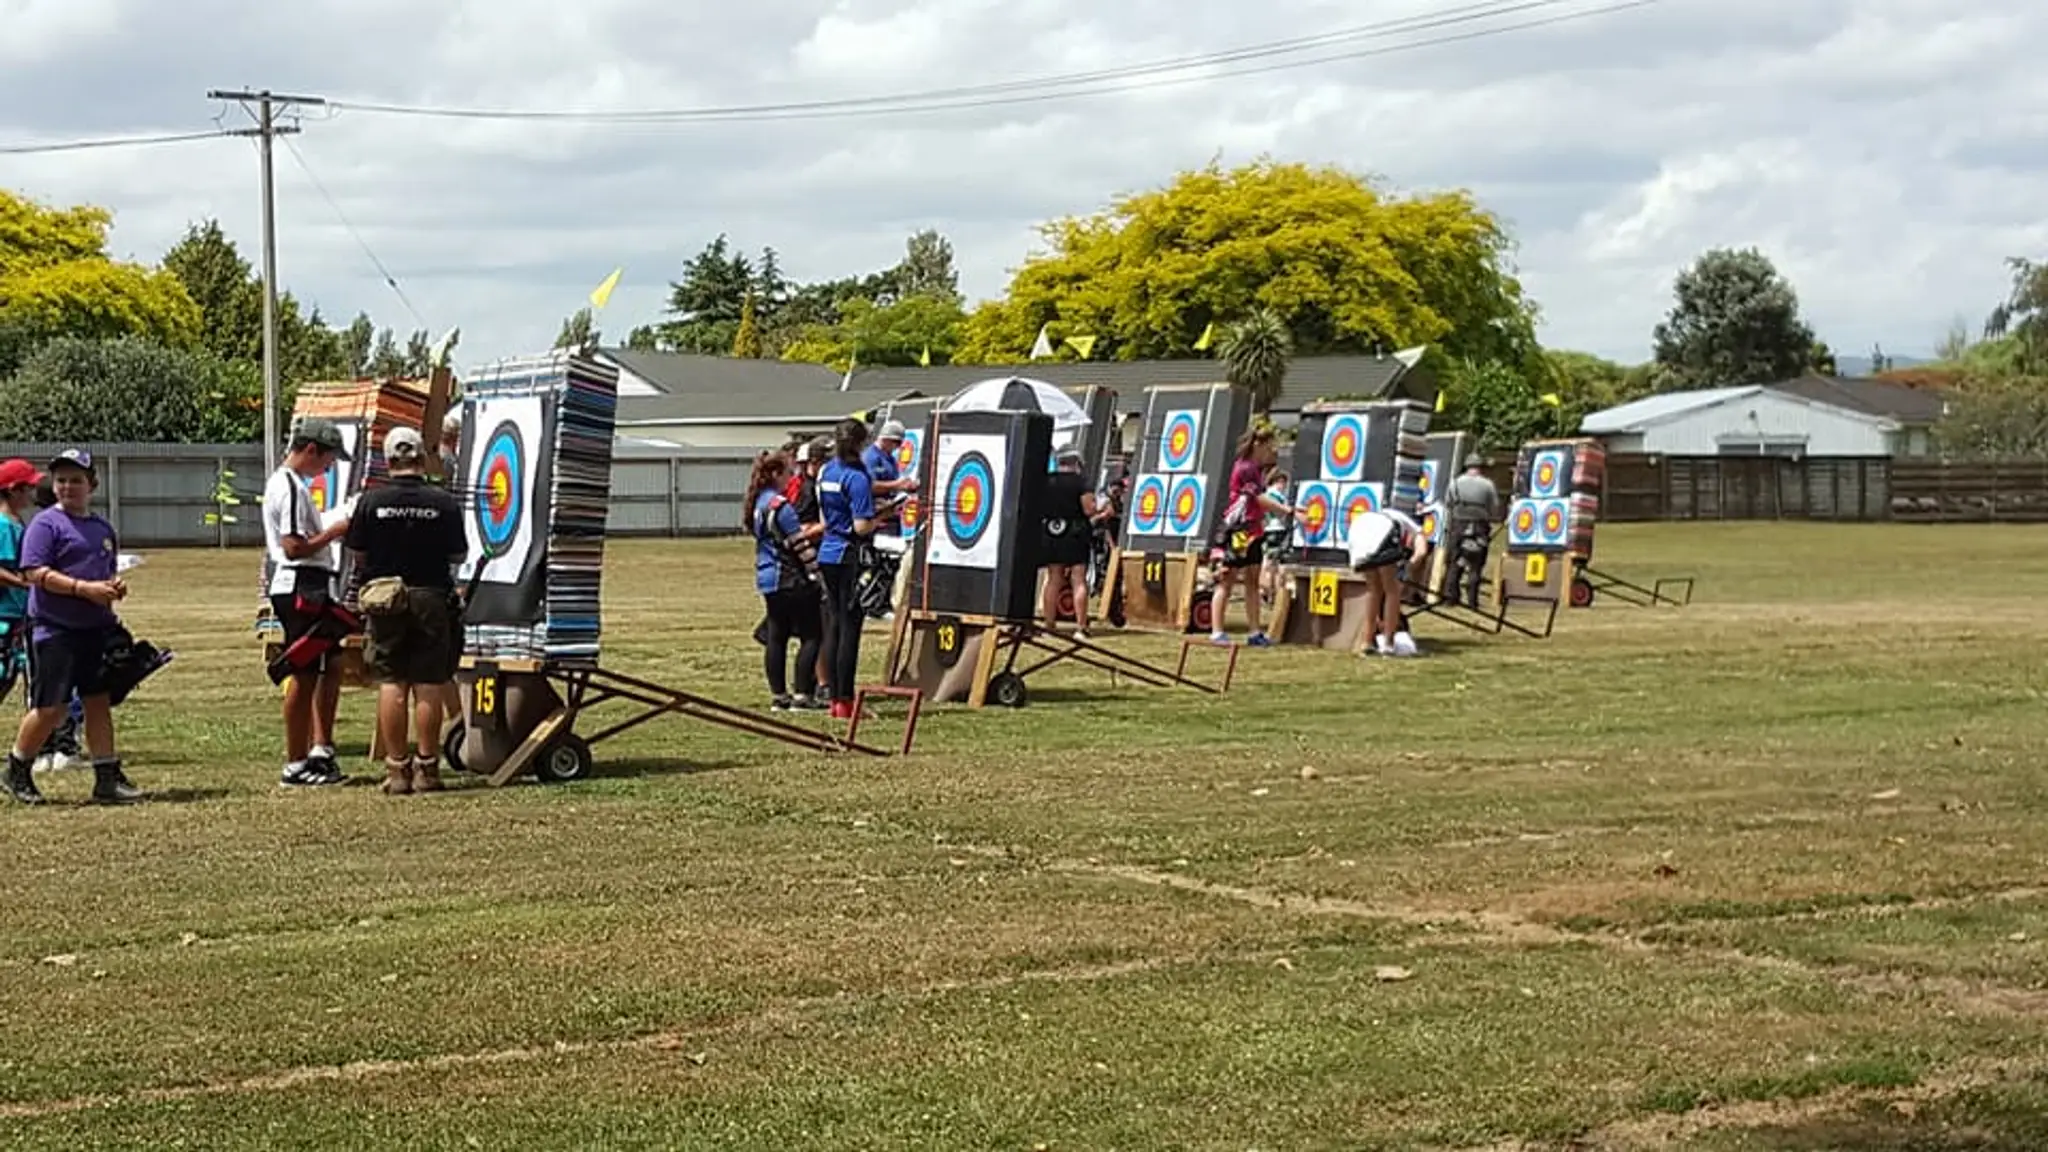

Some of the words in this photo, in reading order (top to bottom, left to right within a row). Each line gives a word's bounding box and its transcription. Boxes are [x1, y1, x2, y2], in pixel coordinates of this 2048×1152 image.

[1146, 562, 1160, 581] 11
[1314, 585, 1333, 606] 12
[938, 625, 955, 651] 13
[476, 677, 495, 713] 15
